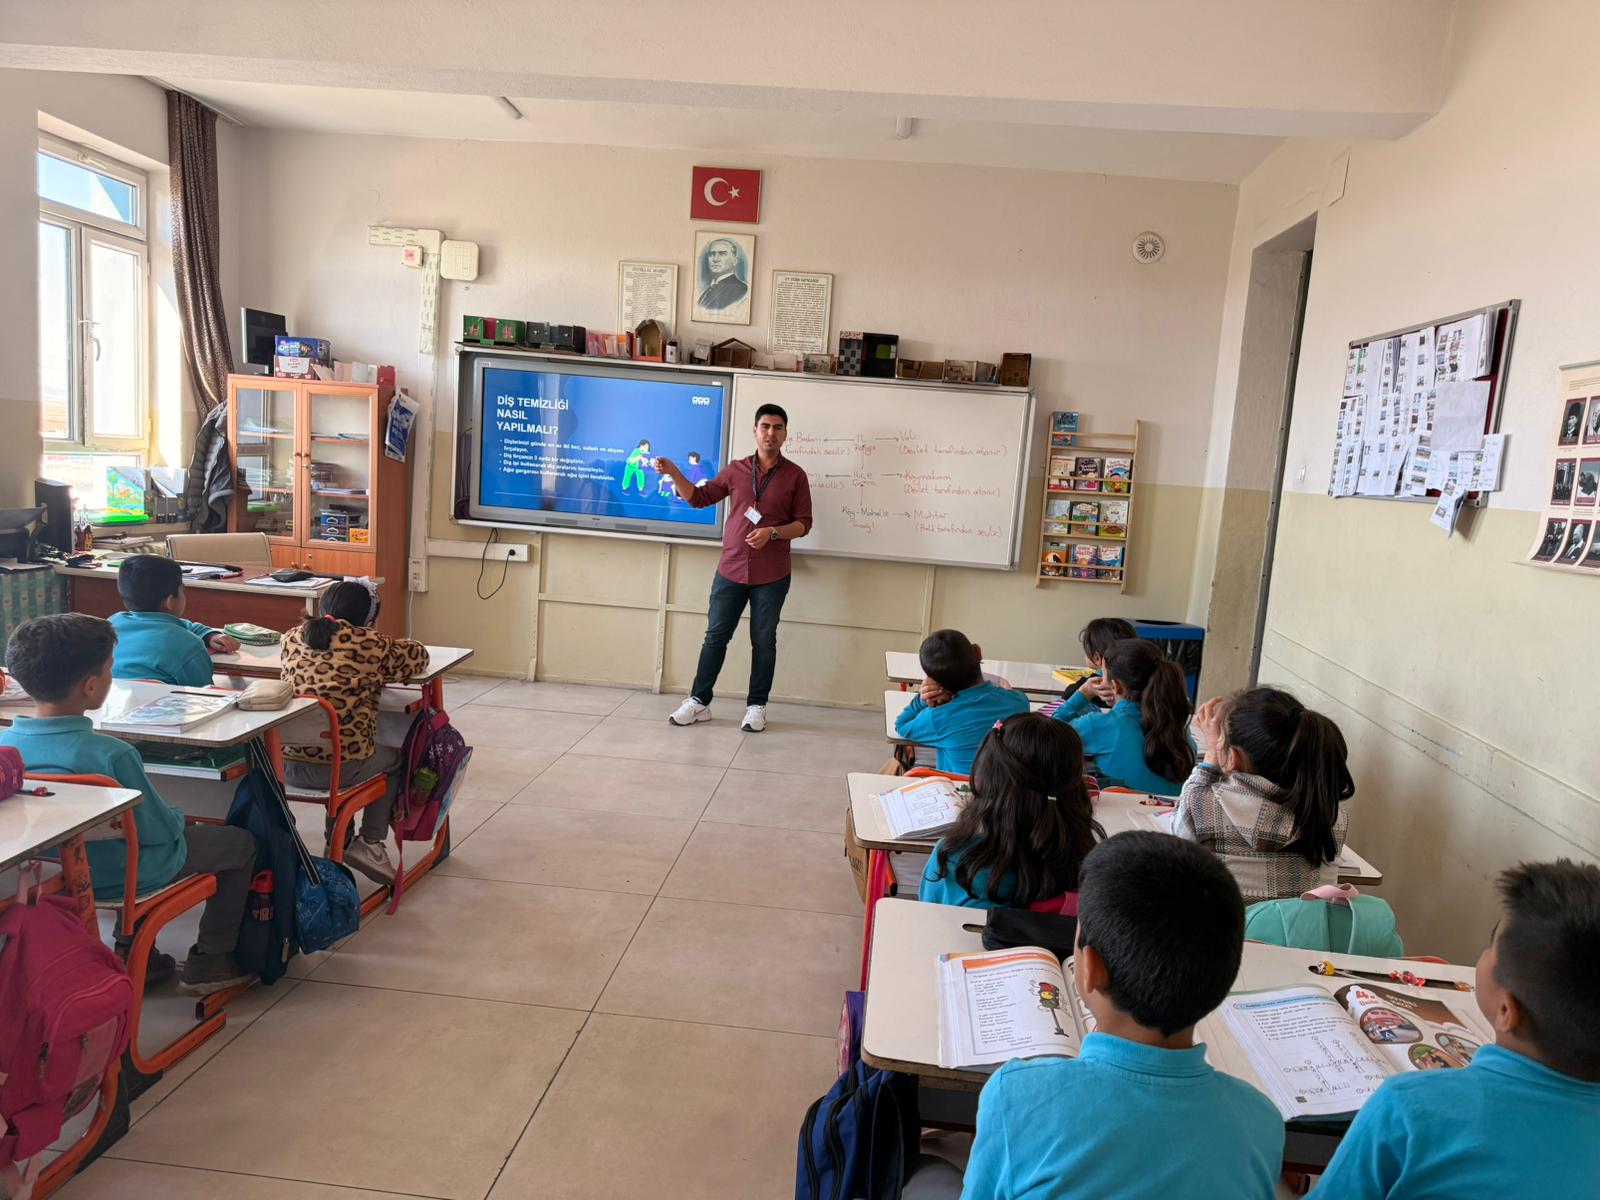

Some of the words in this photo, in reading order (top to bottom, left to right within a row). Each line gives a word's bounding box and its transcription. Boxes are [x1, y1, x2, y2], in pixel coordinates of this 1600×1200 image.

[497, 394, 514, 408] DİŞ
[517, 396, 568, 410] TEMİZLİĞİ
[497, 409, 528, 420] NASIL
[496, 422, 558, 434] YAPILMALI?
